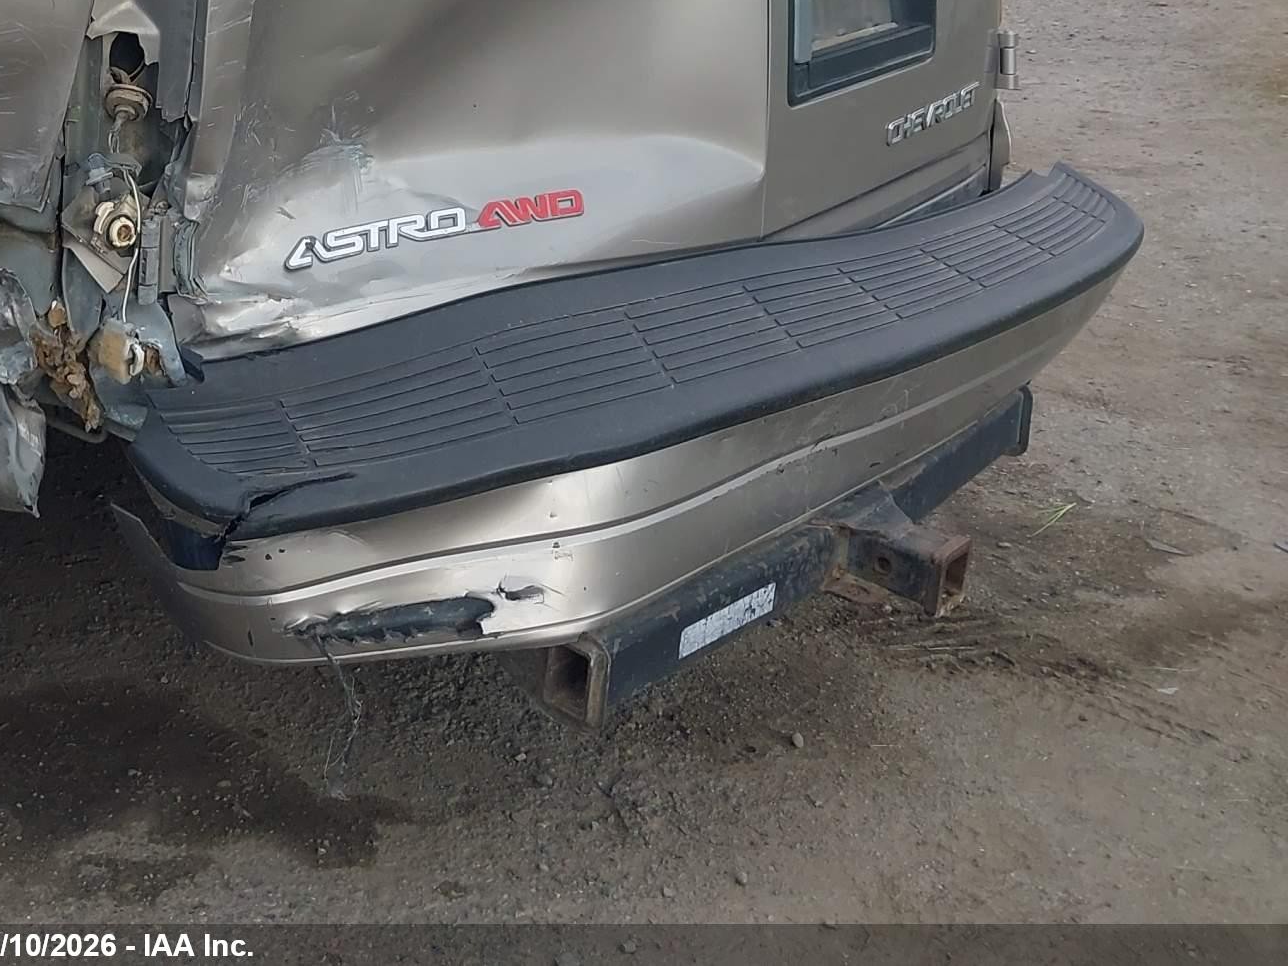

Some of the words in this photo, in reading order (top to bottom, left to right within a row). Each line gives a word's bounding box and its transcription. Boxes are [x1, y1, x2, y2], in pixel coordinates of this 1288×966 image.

[886, 81, 980, 146] CHEVROLET
[284, 206, 467, 271] ASTRO
[476, 189, 585, 229] AWD
